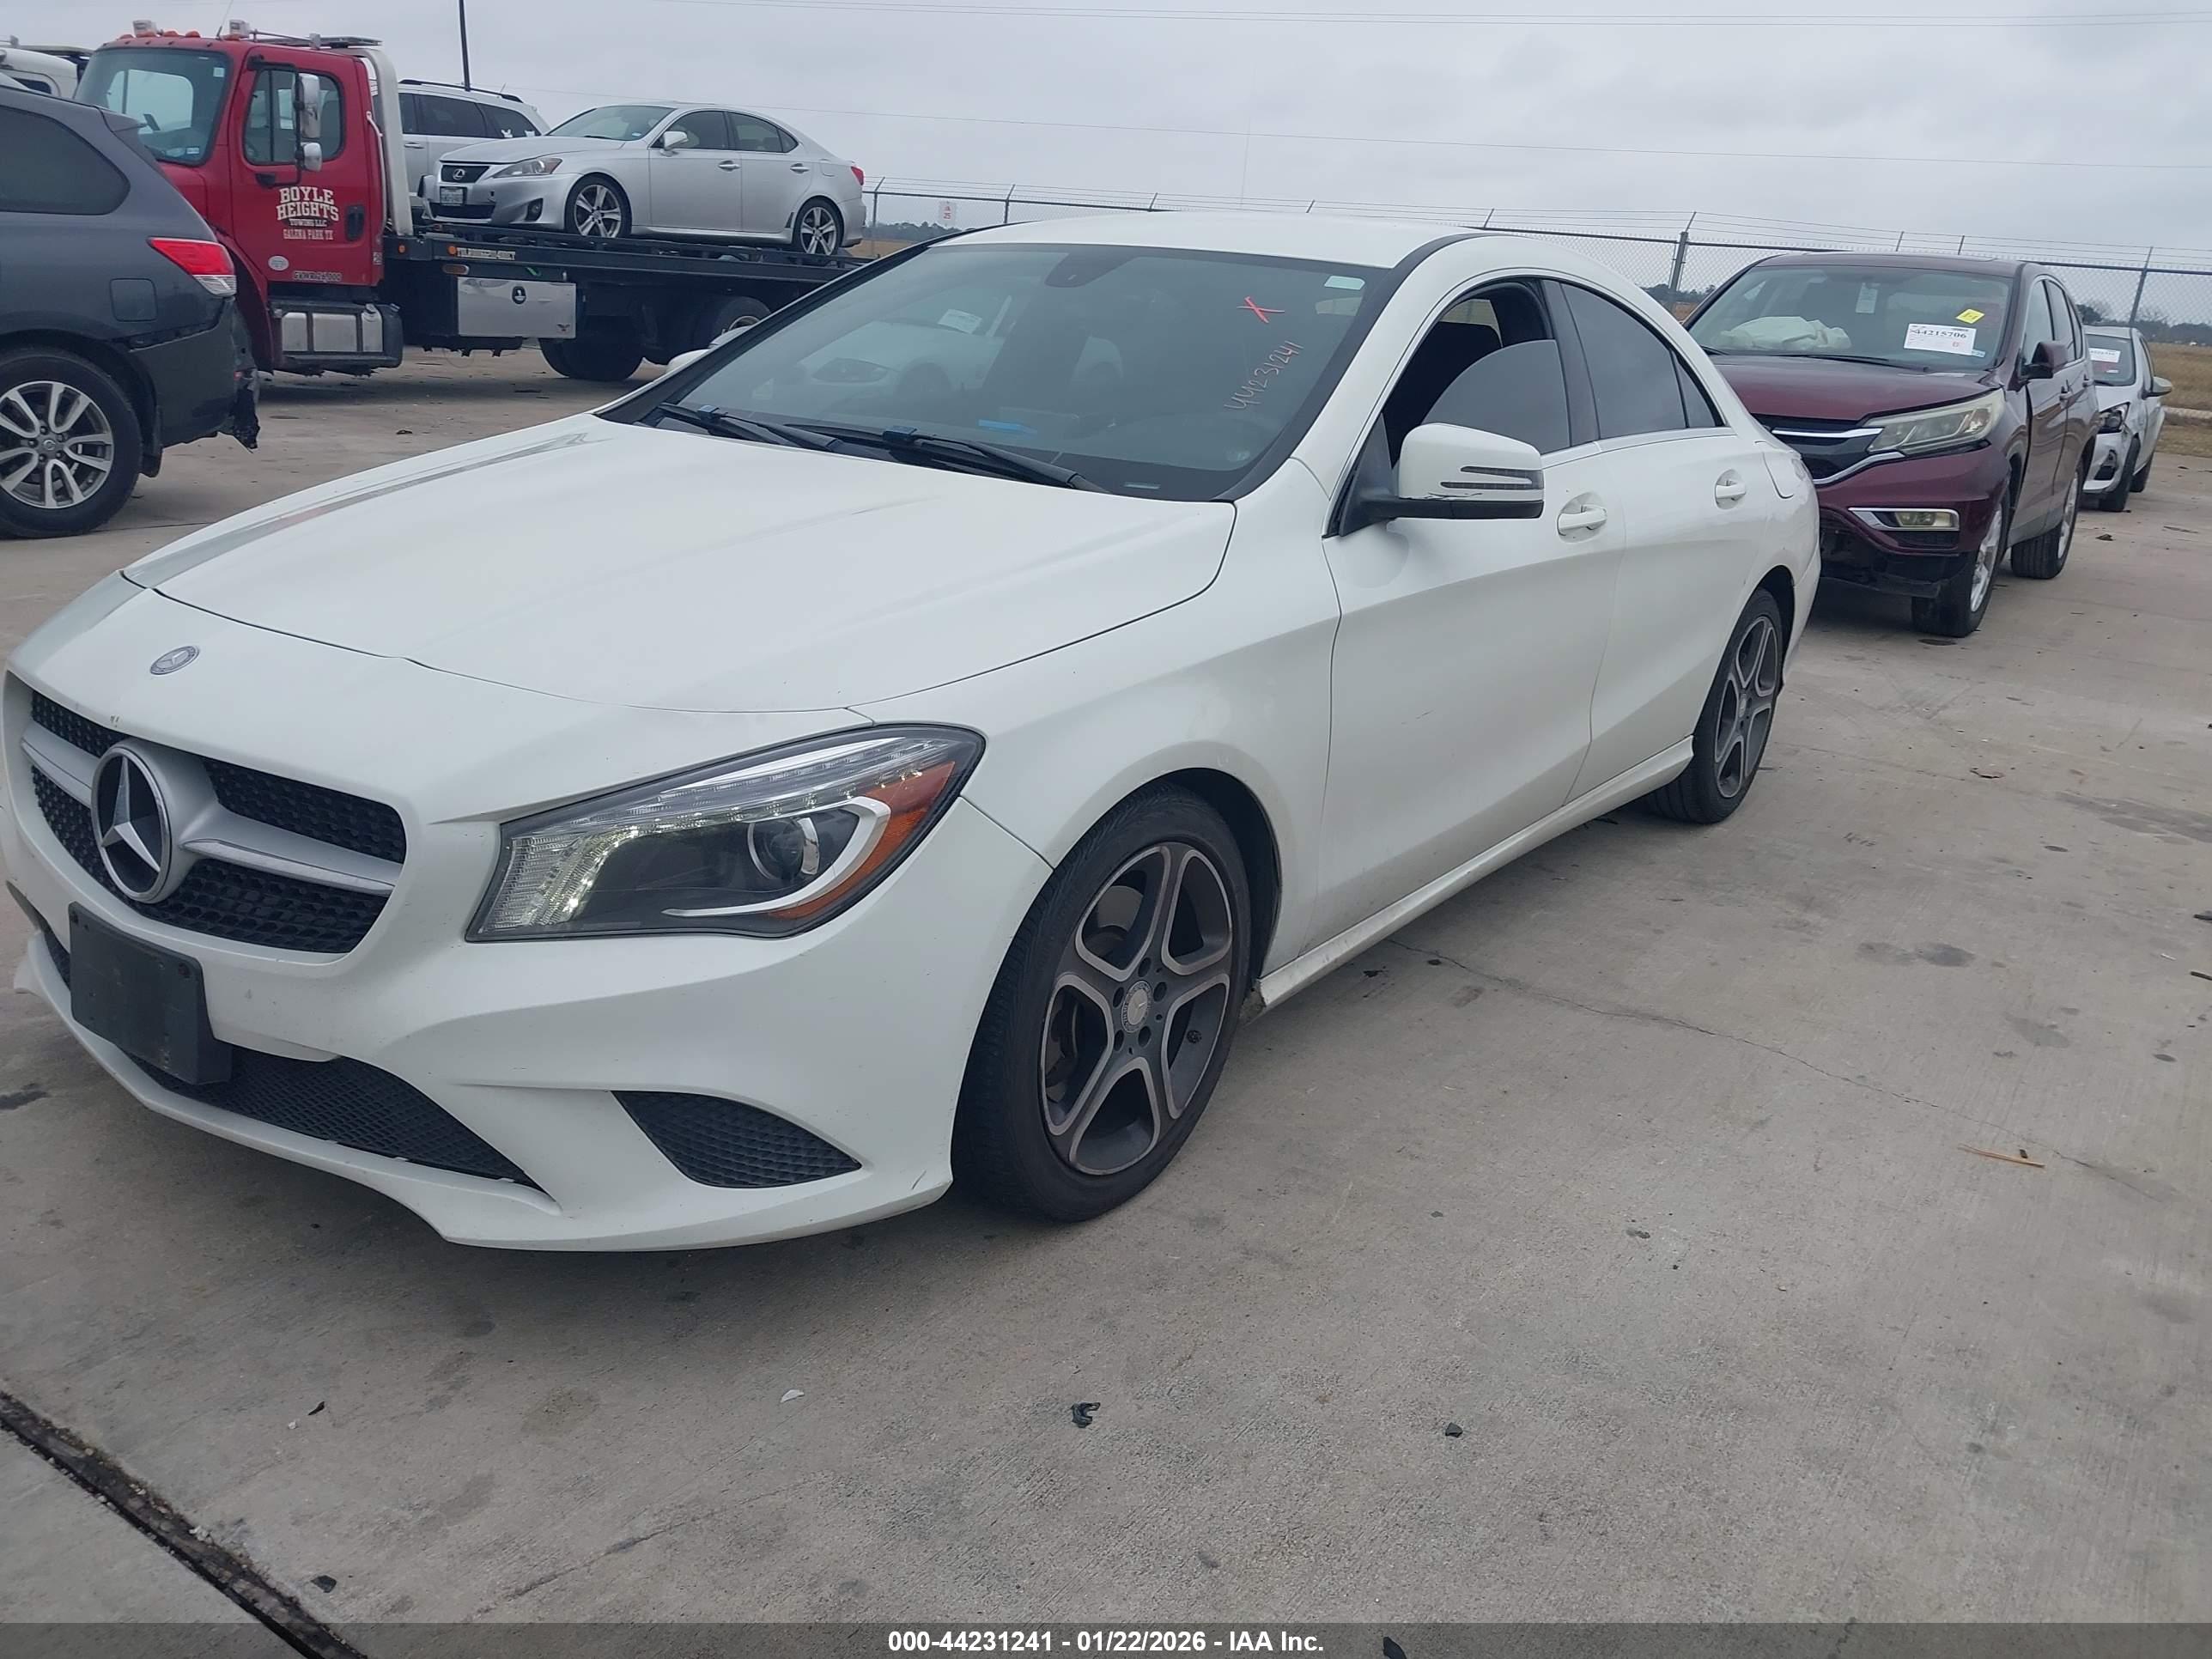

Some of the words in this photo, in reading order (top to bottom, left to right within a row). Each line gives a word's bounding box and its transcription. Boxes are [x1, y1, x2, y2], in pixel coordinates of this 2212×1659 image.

[279, 186, 334, 205] BOYLE
[276, 202, 339, 222] HEIGHTS
[1224, 340, 1304, 410] 44231241
